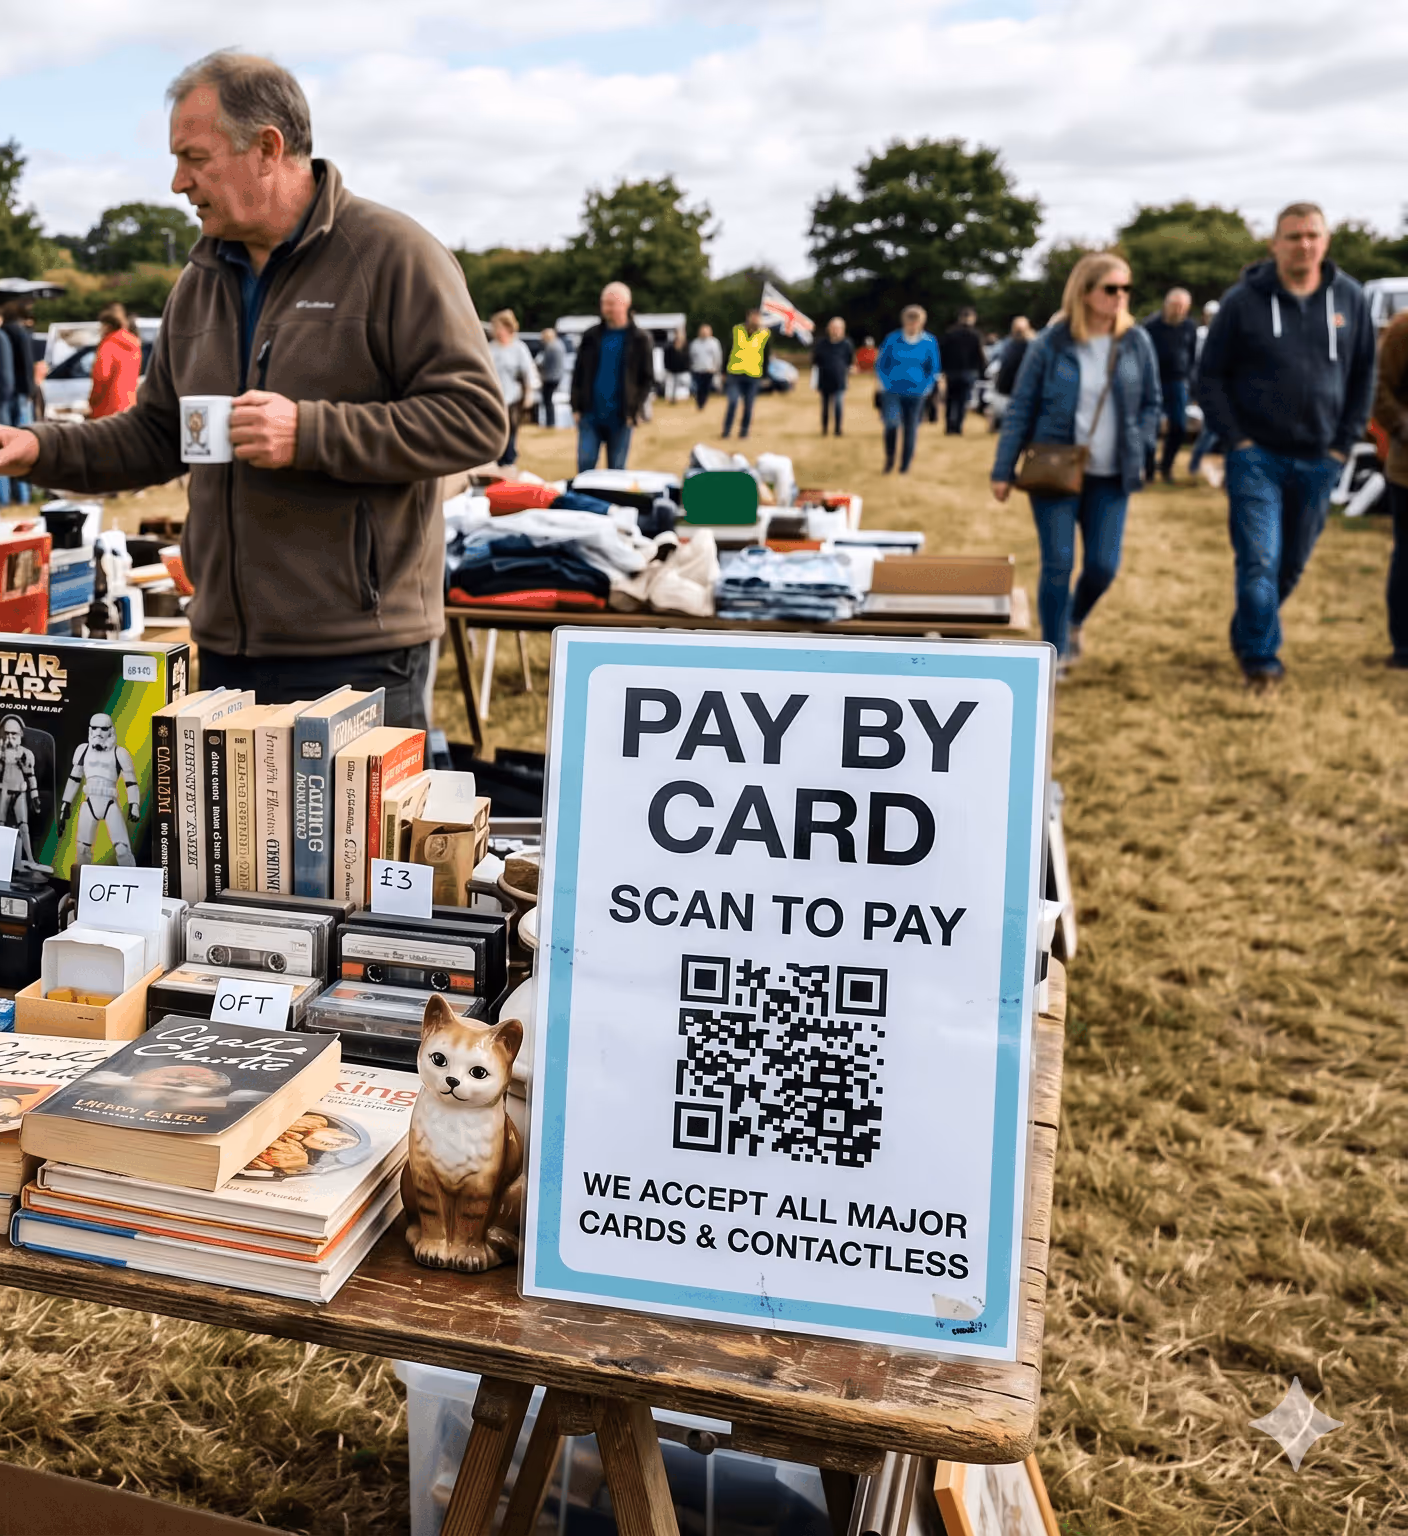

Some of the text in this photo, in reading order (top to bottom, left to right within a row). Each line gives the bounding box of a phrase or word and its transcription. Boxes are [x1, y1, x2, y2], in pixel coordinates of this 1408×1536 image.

[622, 687, 979, 773] PAY BY
[648, 780, 936, 866] CARD
[89, 883, 140, 904] OFT
[380, 866, 413, 890] £3
[609, 884, 967, 947] SCAN TO PAY
[219, 993, 274, 1014] OFT
[133, 1043, 294, 1072] Christie
[582, 1171, 968, 1240] WE ACCEPT ALL MAJOR
[579, 1210, 969, 1280] CARDS & CONTACTLESS
